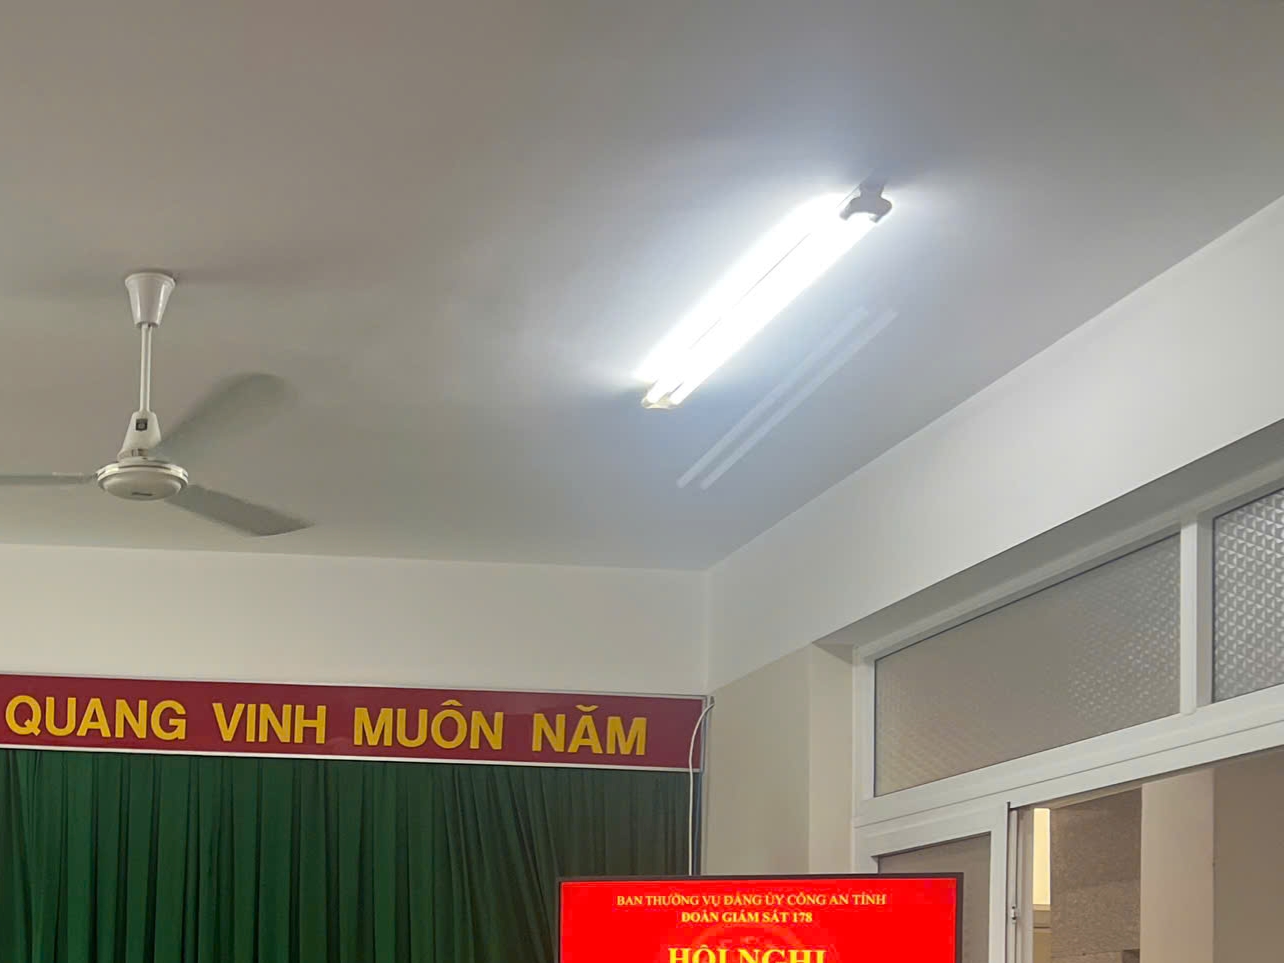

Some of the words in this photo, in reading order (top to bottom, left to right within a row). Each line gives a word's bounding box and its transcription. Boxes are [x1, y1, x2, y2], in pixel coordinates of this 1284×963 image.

[5, 693, 187, 742] QUANG
[212, 701, 326, 745] VINH
[353, 698, 504, 750] MUÔN
[531, 704, 647, 756] NĂM
[617, 895, 643, 906] BAN
[646, 892, 699, 906] THƯỜNG
[702, 895, 720, 907] VỤ
[723, 892, 762, 906] ĐẢNG
[765, 891, 785, 905] ỦY
[787, 891, 826, 906] CÔNG
[829, 895, 849, 905] AN
[852, 891, 887, 905] TỈNH
[681, 910, 719, 923] ĐOÀN
[722, 909, 759, 923] GIÁM
[762, 909, 789, 923] SÁT
[792, 912, 813, 923] 178
